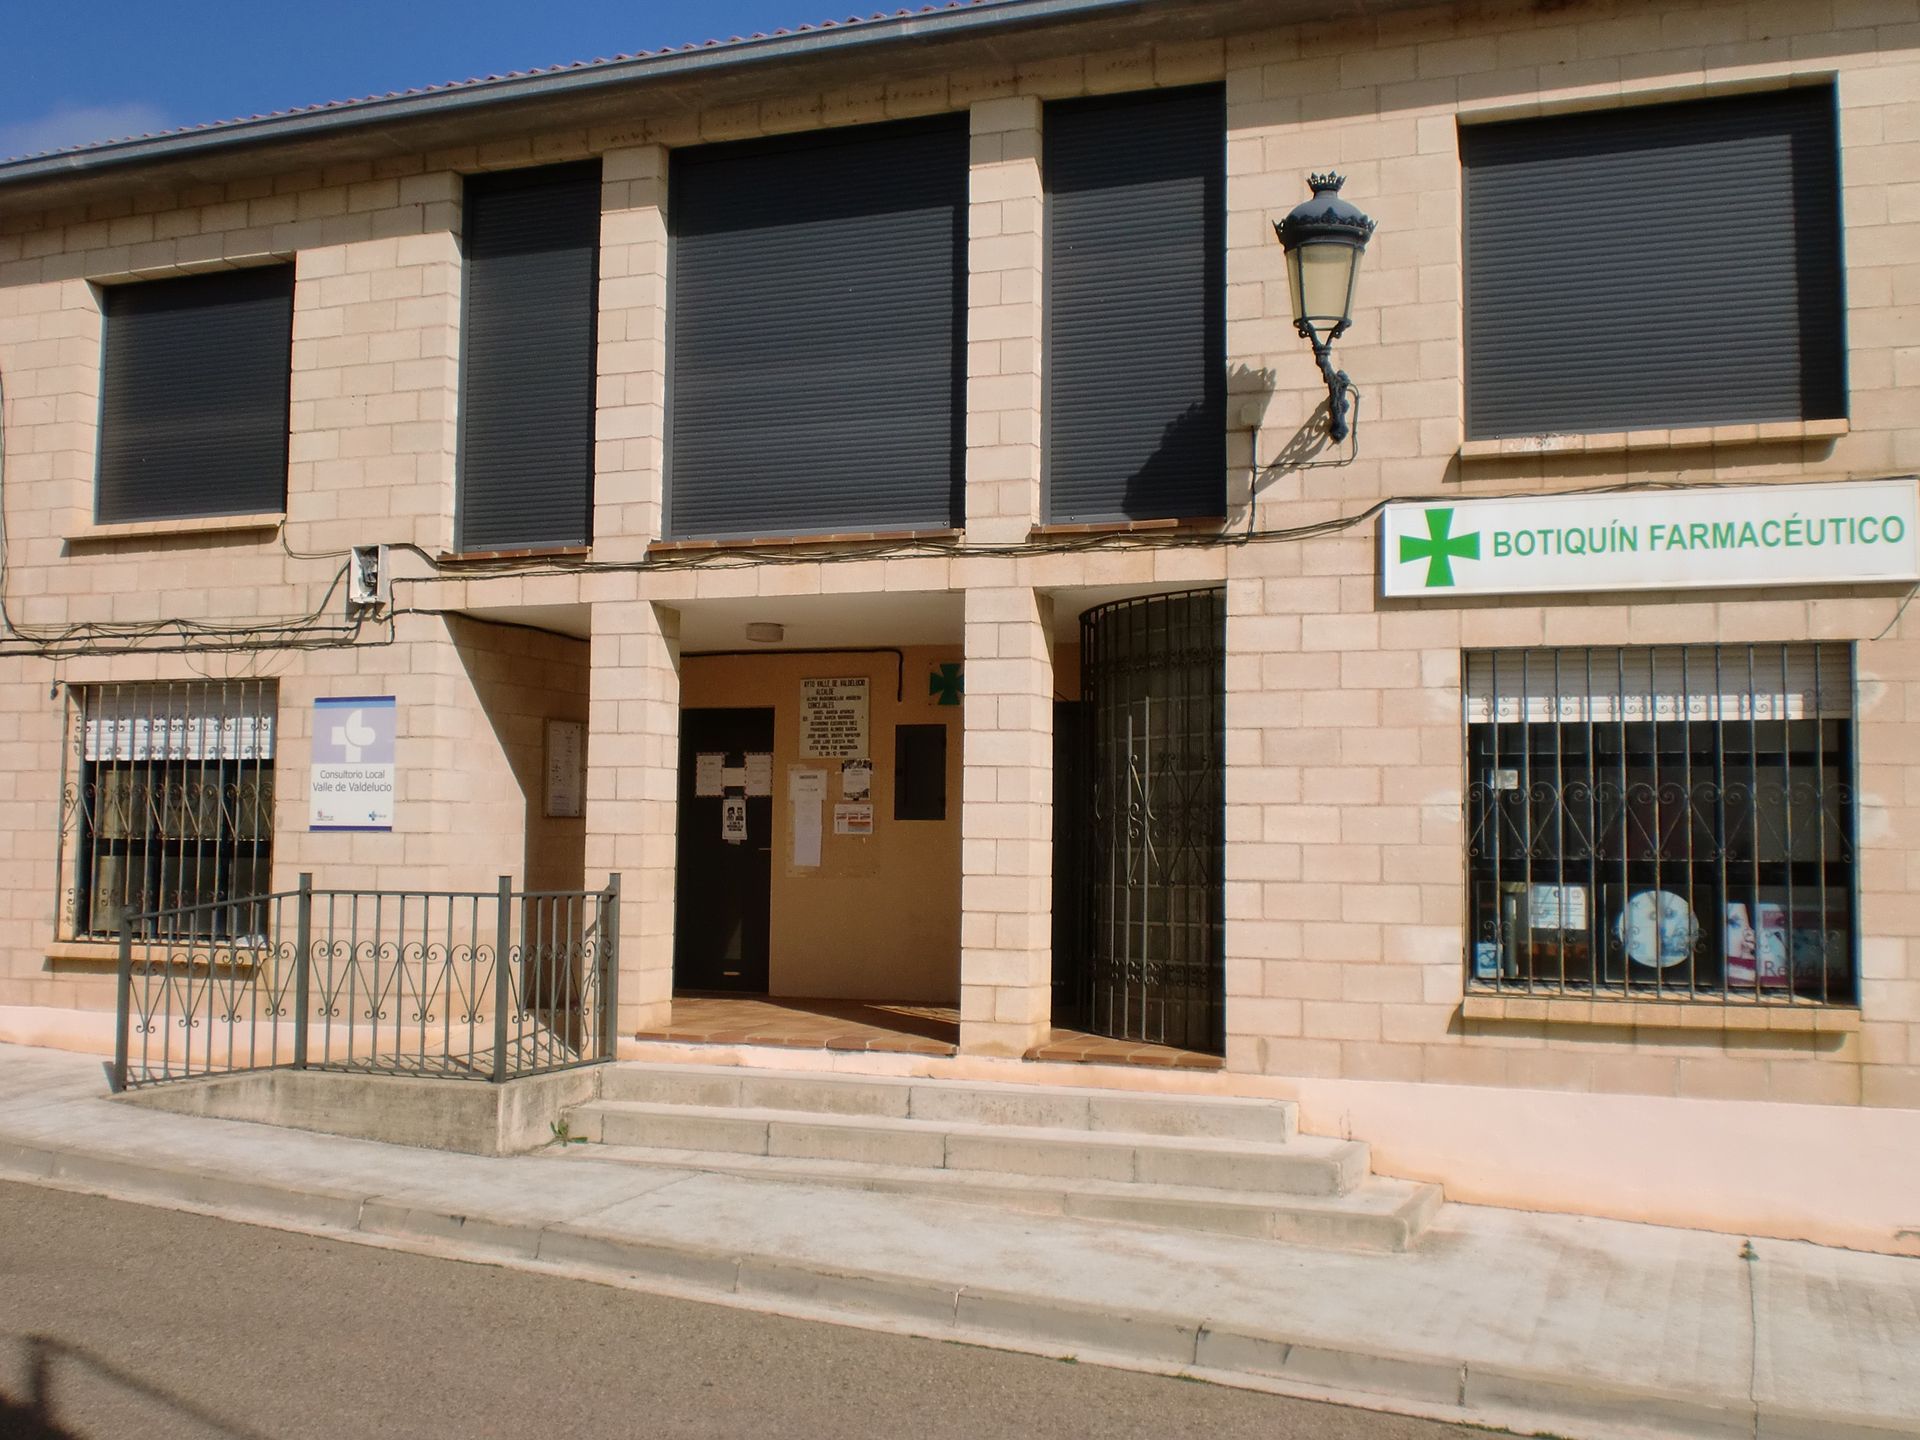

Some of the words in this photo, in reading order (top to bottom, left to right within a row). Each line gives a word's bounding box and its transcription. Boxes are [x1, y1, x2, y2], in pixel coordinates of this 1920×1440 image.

[1494, 518, 1638, 557] BOTIQUÍN
[1650, 512, 1905, 551] FARMACÉUTICO
[320, 769, 363, 779] Consultorio
[365, 769, 385, 779] Local
[313, 782, 333, 792] Valle
[335, 782, 346, 792] de
[349, 782, 392, 792] Valdelucio
